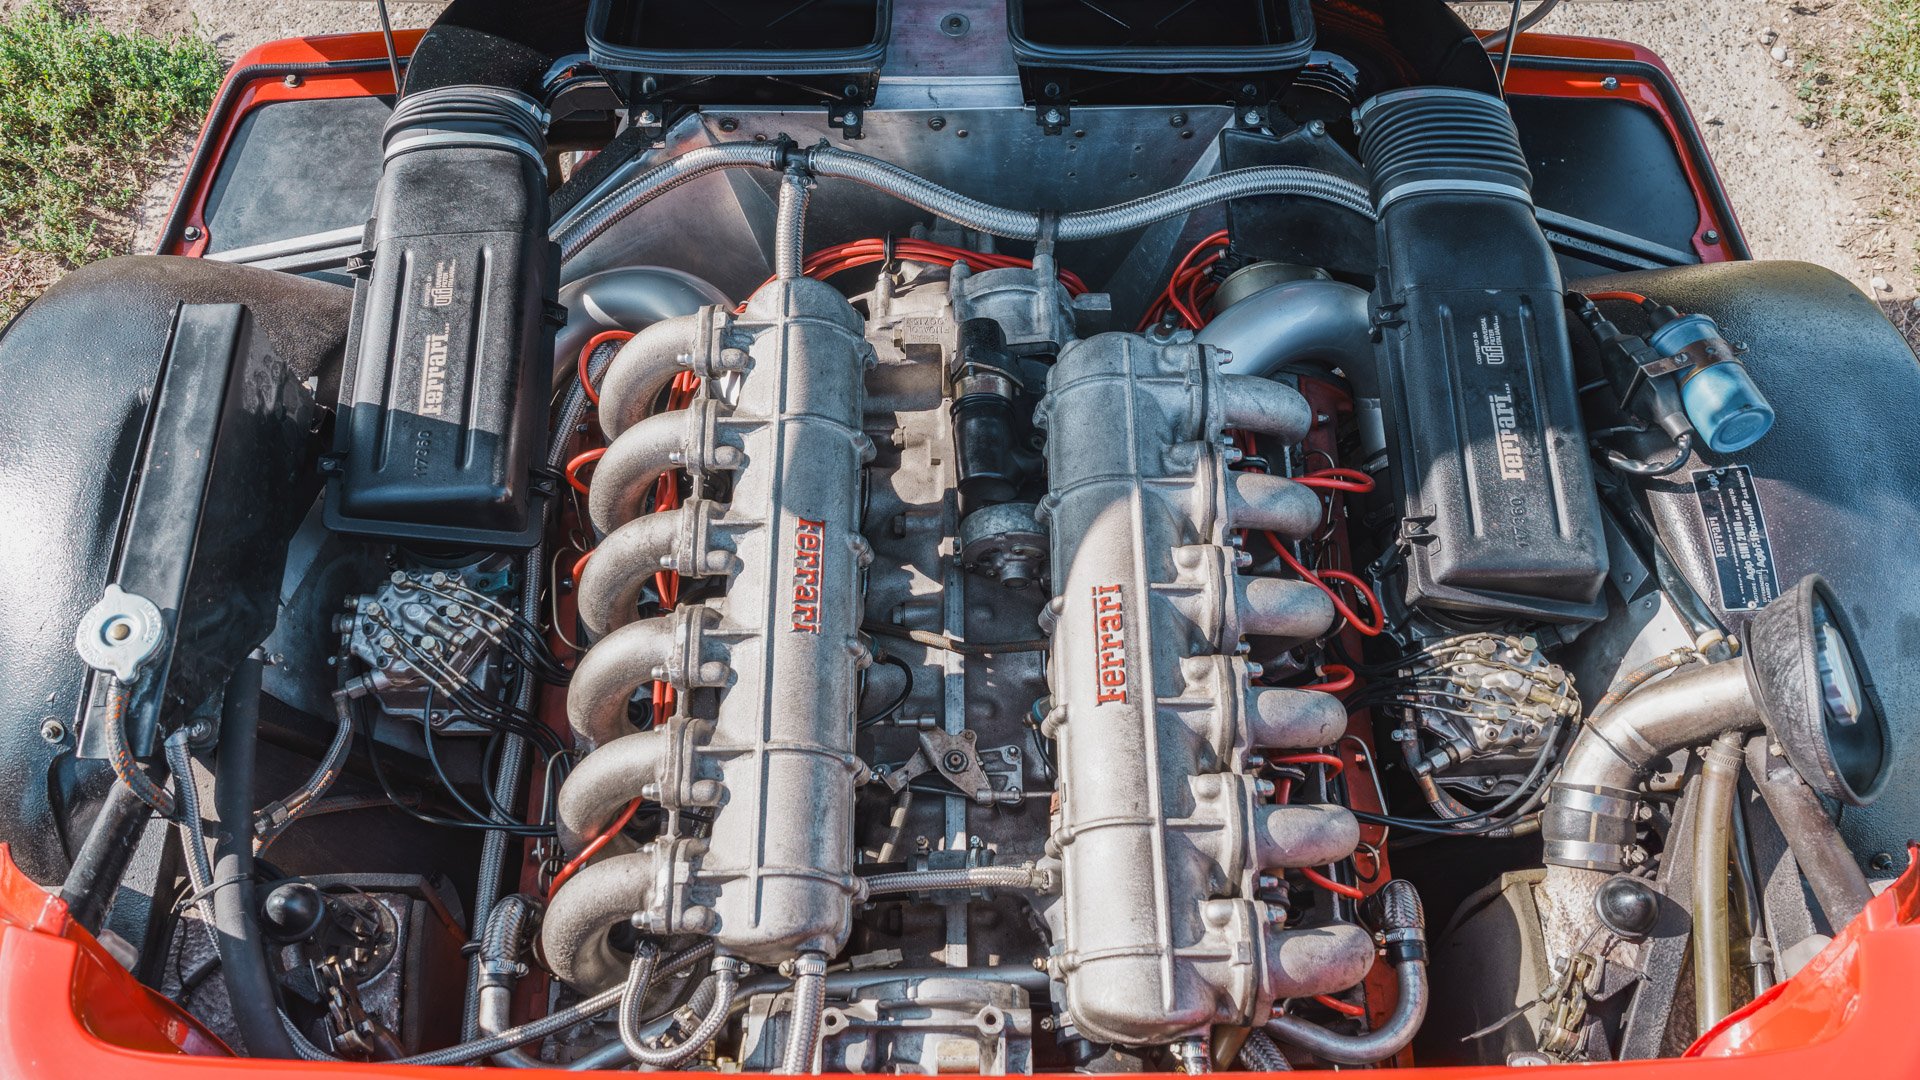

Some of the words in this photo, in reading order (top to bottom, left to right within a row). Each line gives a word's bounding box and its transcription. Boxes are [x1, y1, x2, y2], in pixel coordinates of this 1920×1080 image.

[1480, 317, 1490, 345] UNIVERSAL
[1488, 329, 1496, 345] FILTER
[418, 334, 449, 416] Ferrari
[1489, 394, 1525, 481] Ferrari
[1707, 474, 1719, 490] Agip
[1734, 509, 1742, 520] SAE
[1706, 517, 1727, 558] Ferrari
[1733, 522, 1746, 541] 2000
[1738, 543, 1750, 559] SINT
[1754, 548, 1766, 568] Agip
[791, 516, 825, 634] Ferrari
[1743, 561, 1755, 580] Agip
[1091, 584, 1127, 705] Ferrari
